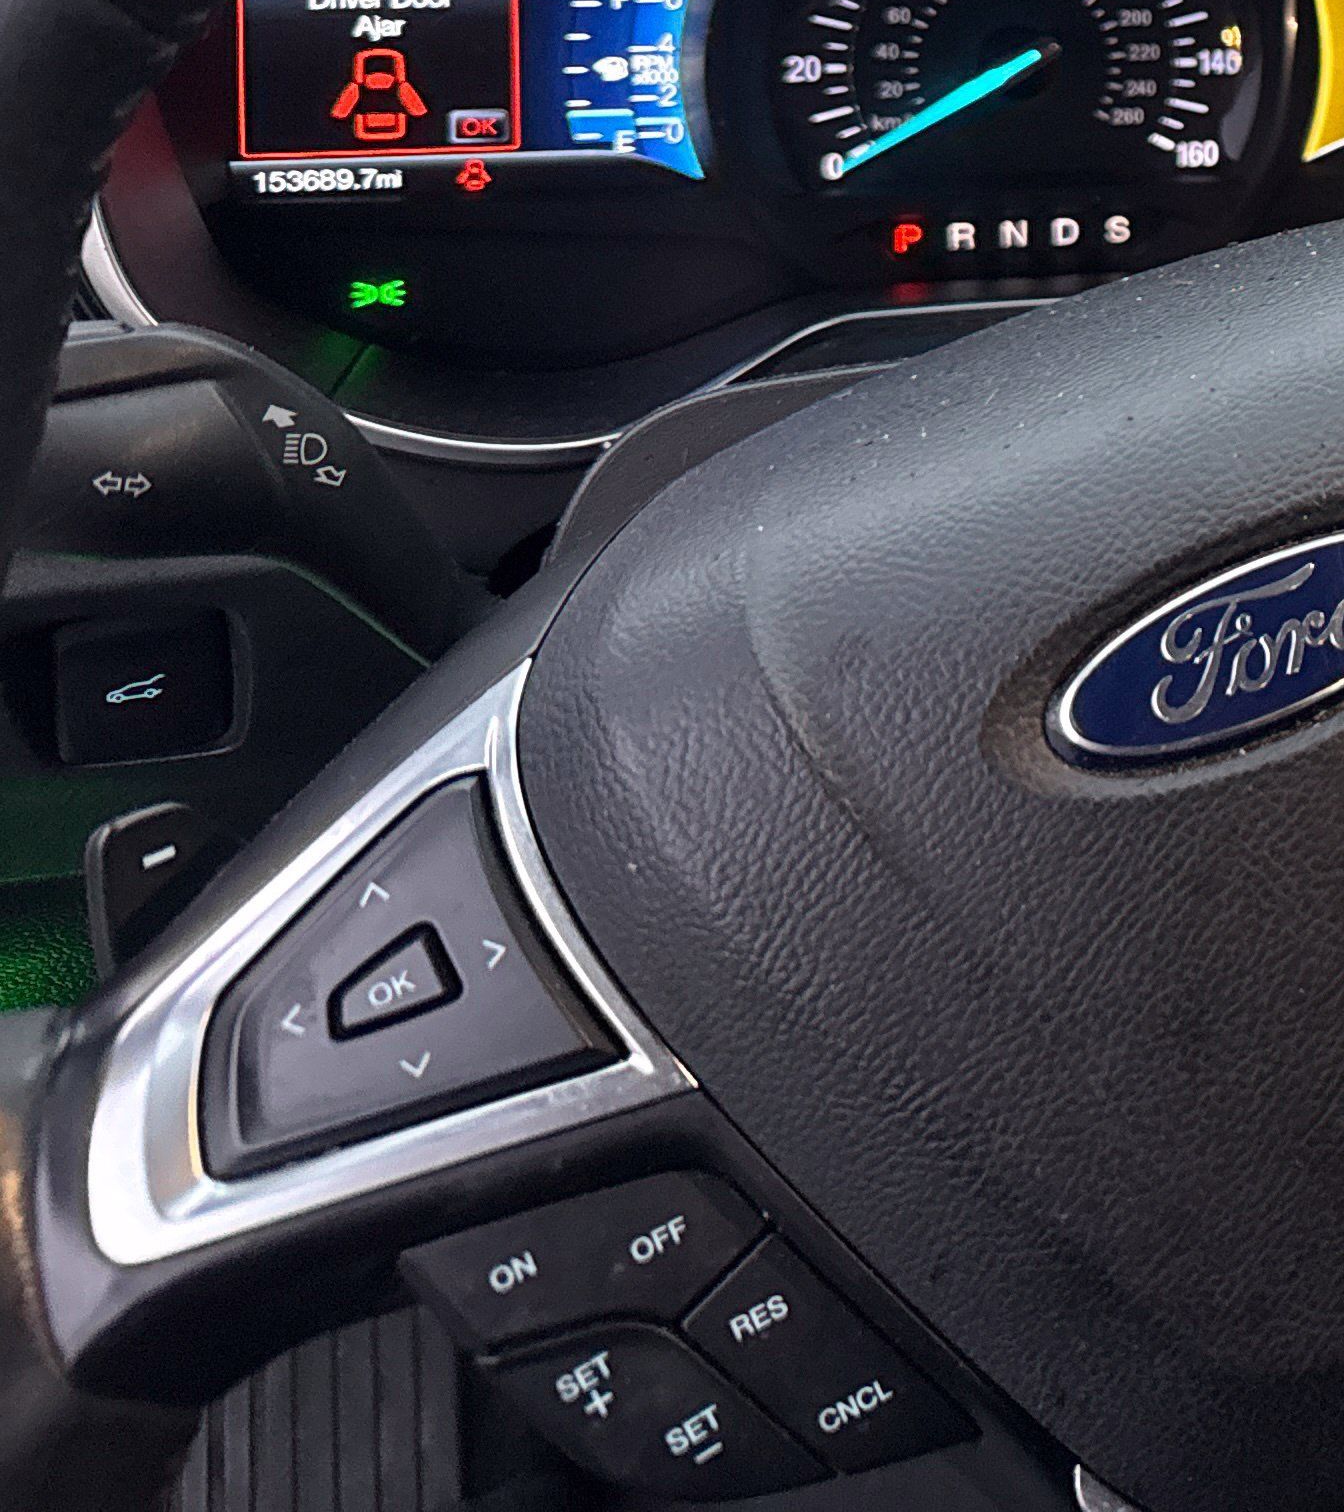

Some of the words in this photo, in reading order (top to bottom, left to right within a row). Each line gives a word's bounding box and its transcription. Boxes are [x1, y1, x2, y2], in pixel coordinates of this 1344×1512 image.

[351, 15, 407, 40] Ajar
[1120, 9, 1153, 28] 200
[656, 31, 677, 53] 4
[1128, 43, 1161, 62] 220
[781, 56, 822, 83] 20
[1197, 49, 1243, 75] 140
[658, 83, 679, 108] 2
[879, 79, 904, 100] 20
[460, 116, 498, 136] OK
[665, 120, 685, 145] 0
[613, 129, 638, 154] E
[819, 153, 847, 180] 0
[1174, 141, 1220, 169] 160
[252, 168, 403, 194] 153689.7mi
[892, 222, 924, 255] P
[945, 221, 977, 250] R
[998, 219, 1030, 248] N
[1051, 217, 1082, 247] D
[1103, 215, 1132, 244] S
[367, 968, 418, 1009] OK
[629, 1214, 687, 1266] OFF
[488, 1250, 540, 1294] ON
[728, 1293, 790, 1343] RES
[554, 1351, 610, 1403] SET
[816, 1380, 894, 1434] CNCL
[664, 1404, 719, 1457] SET
